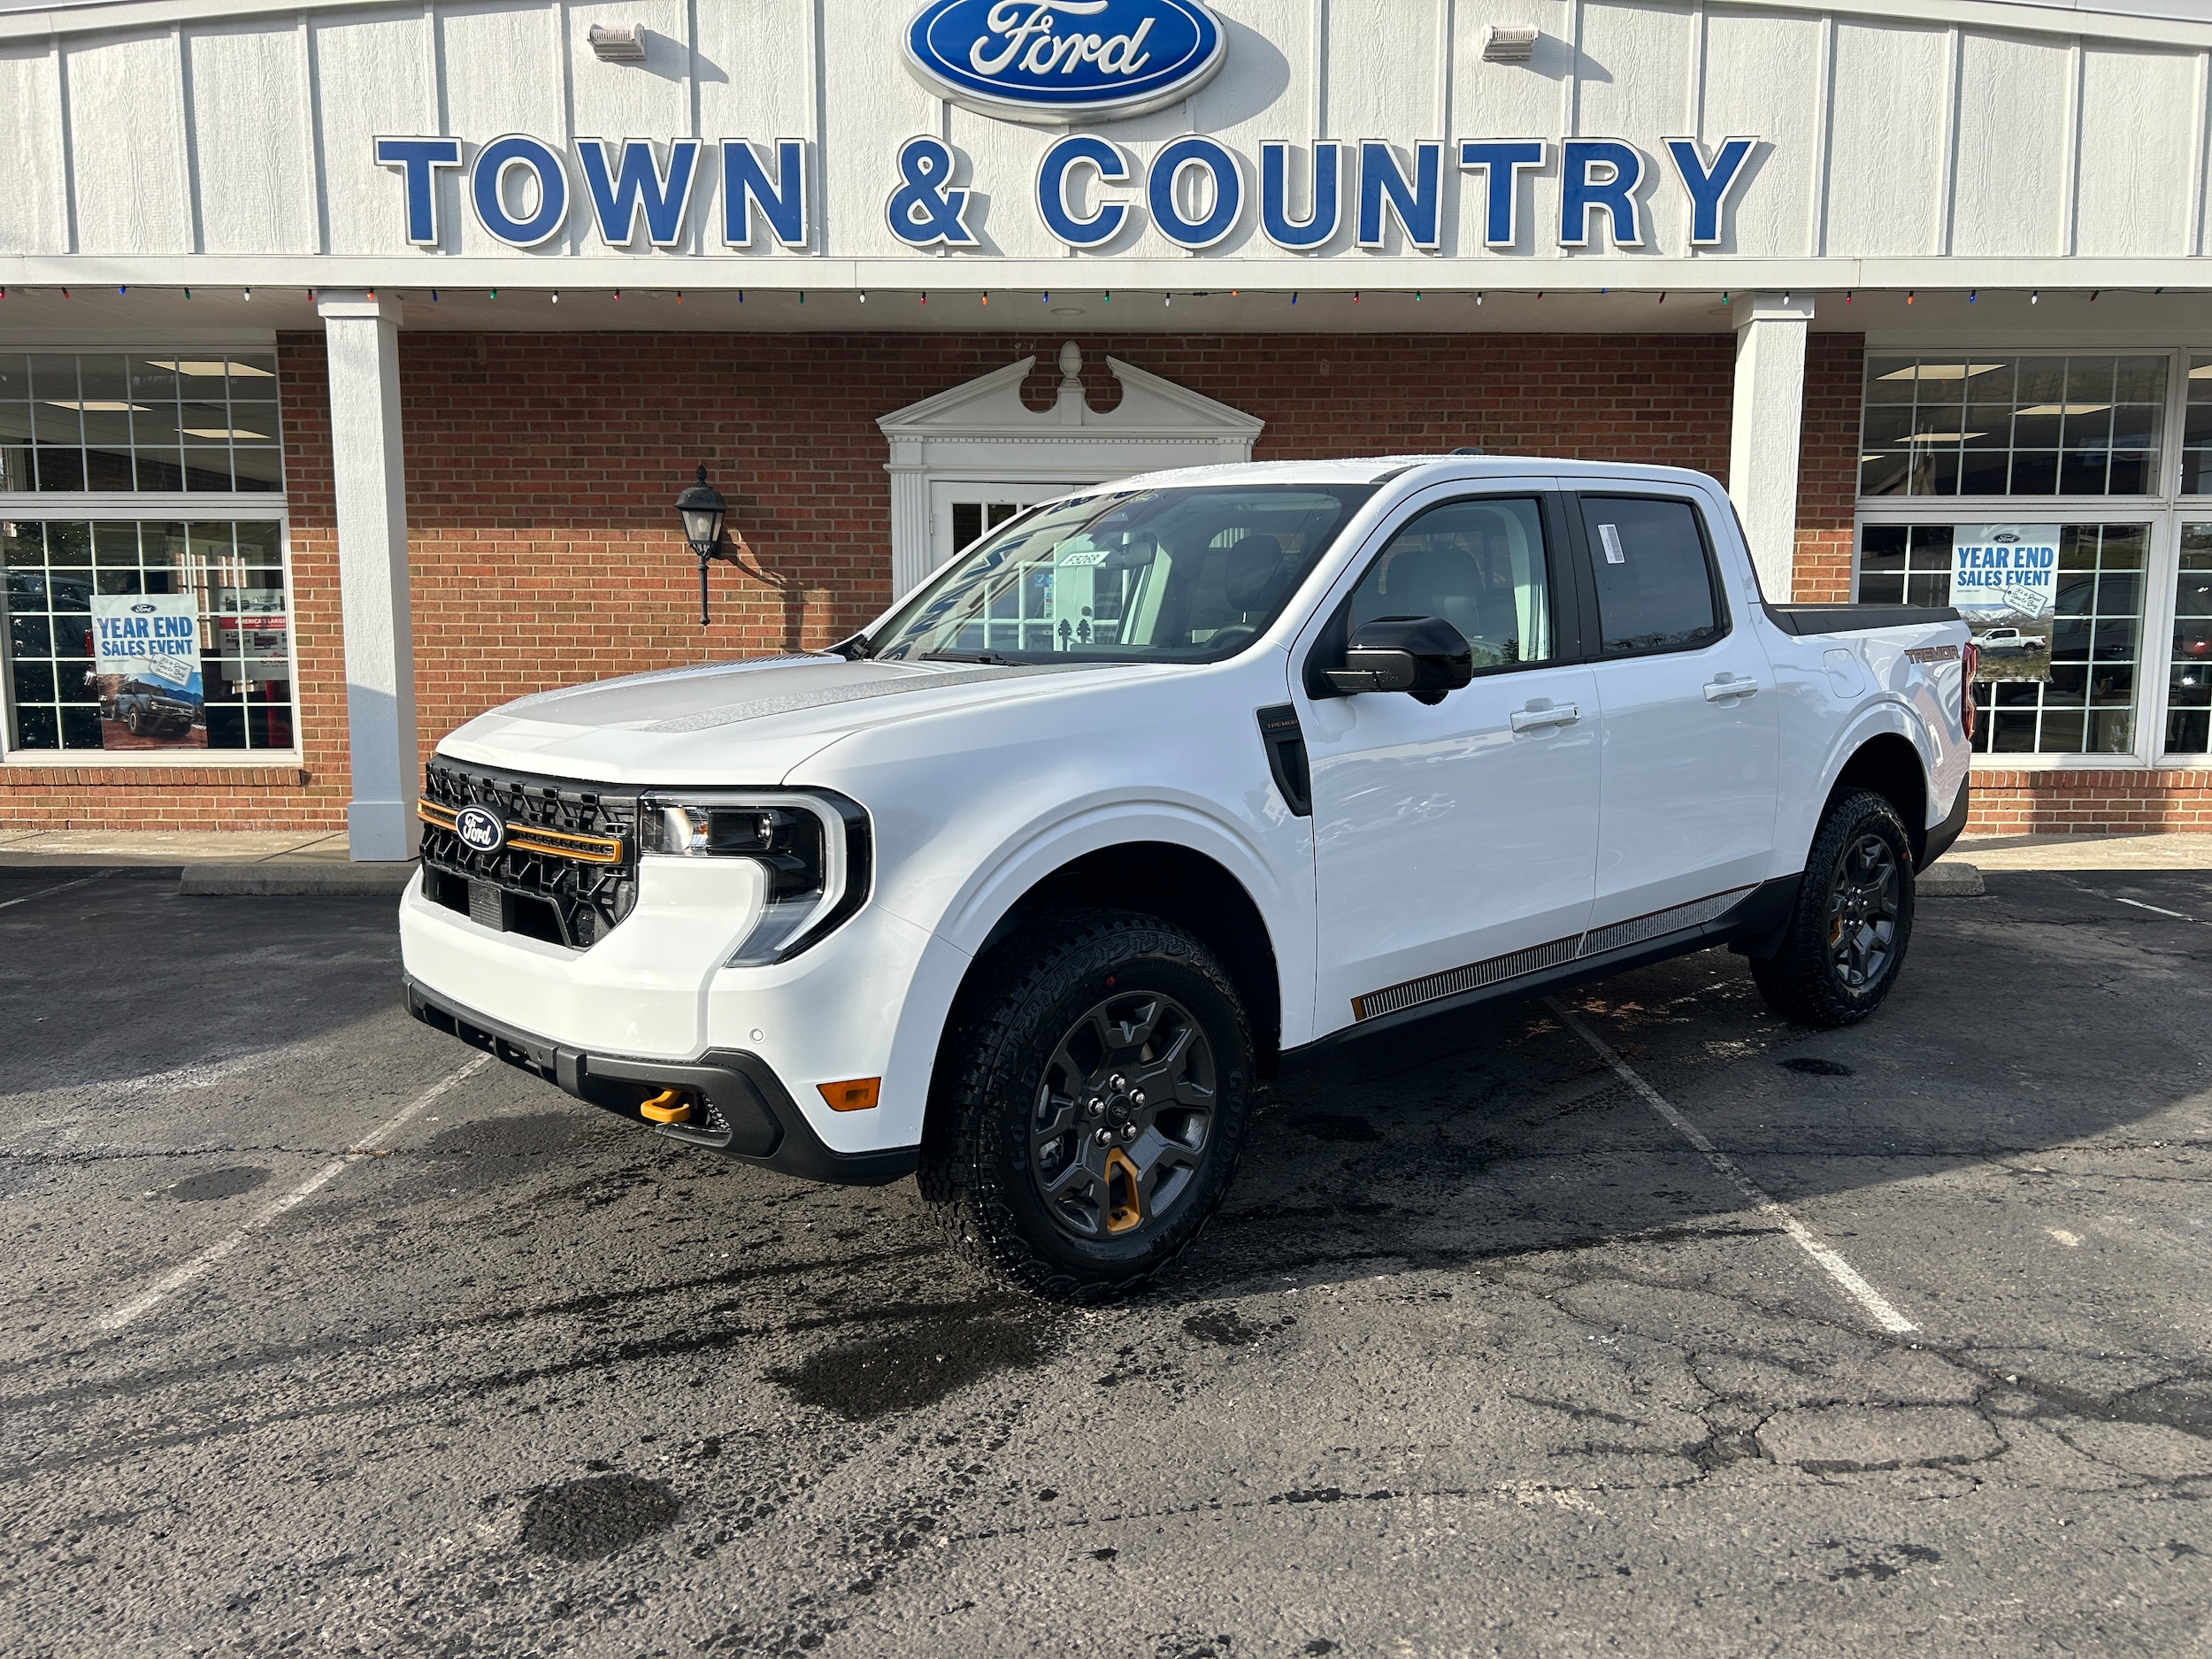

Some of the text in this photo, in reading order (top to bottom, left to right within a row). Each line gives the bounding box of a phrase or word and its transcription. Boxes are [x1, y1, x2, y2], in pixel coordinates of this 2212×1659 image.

[969, 0, 1156, 76] Ford
[372, 133, 1761, 250] TOWN & COUNTRY
[1064, 554, 1100, 565] F5268
[1957, 547, 2054, 568] YEAR END
[1957, 570, 2052, 587] SALES EVENT
[96, 616, 193, 639] YEAR END
[101, 639, 193, 657] SALES EVENT
[1904, 645, 1961, 664] TREMOR
[1266, 718, 1298, 729] TREMOR
